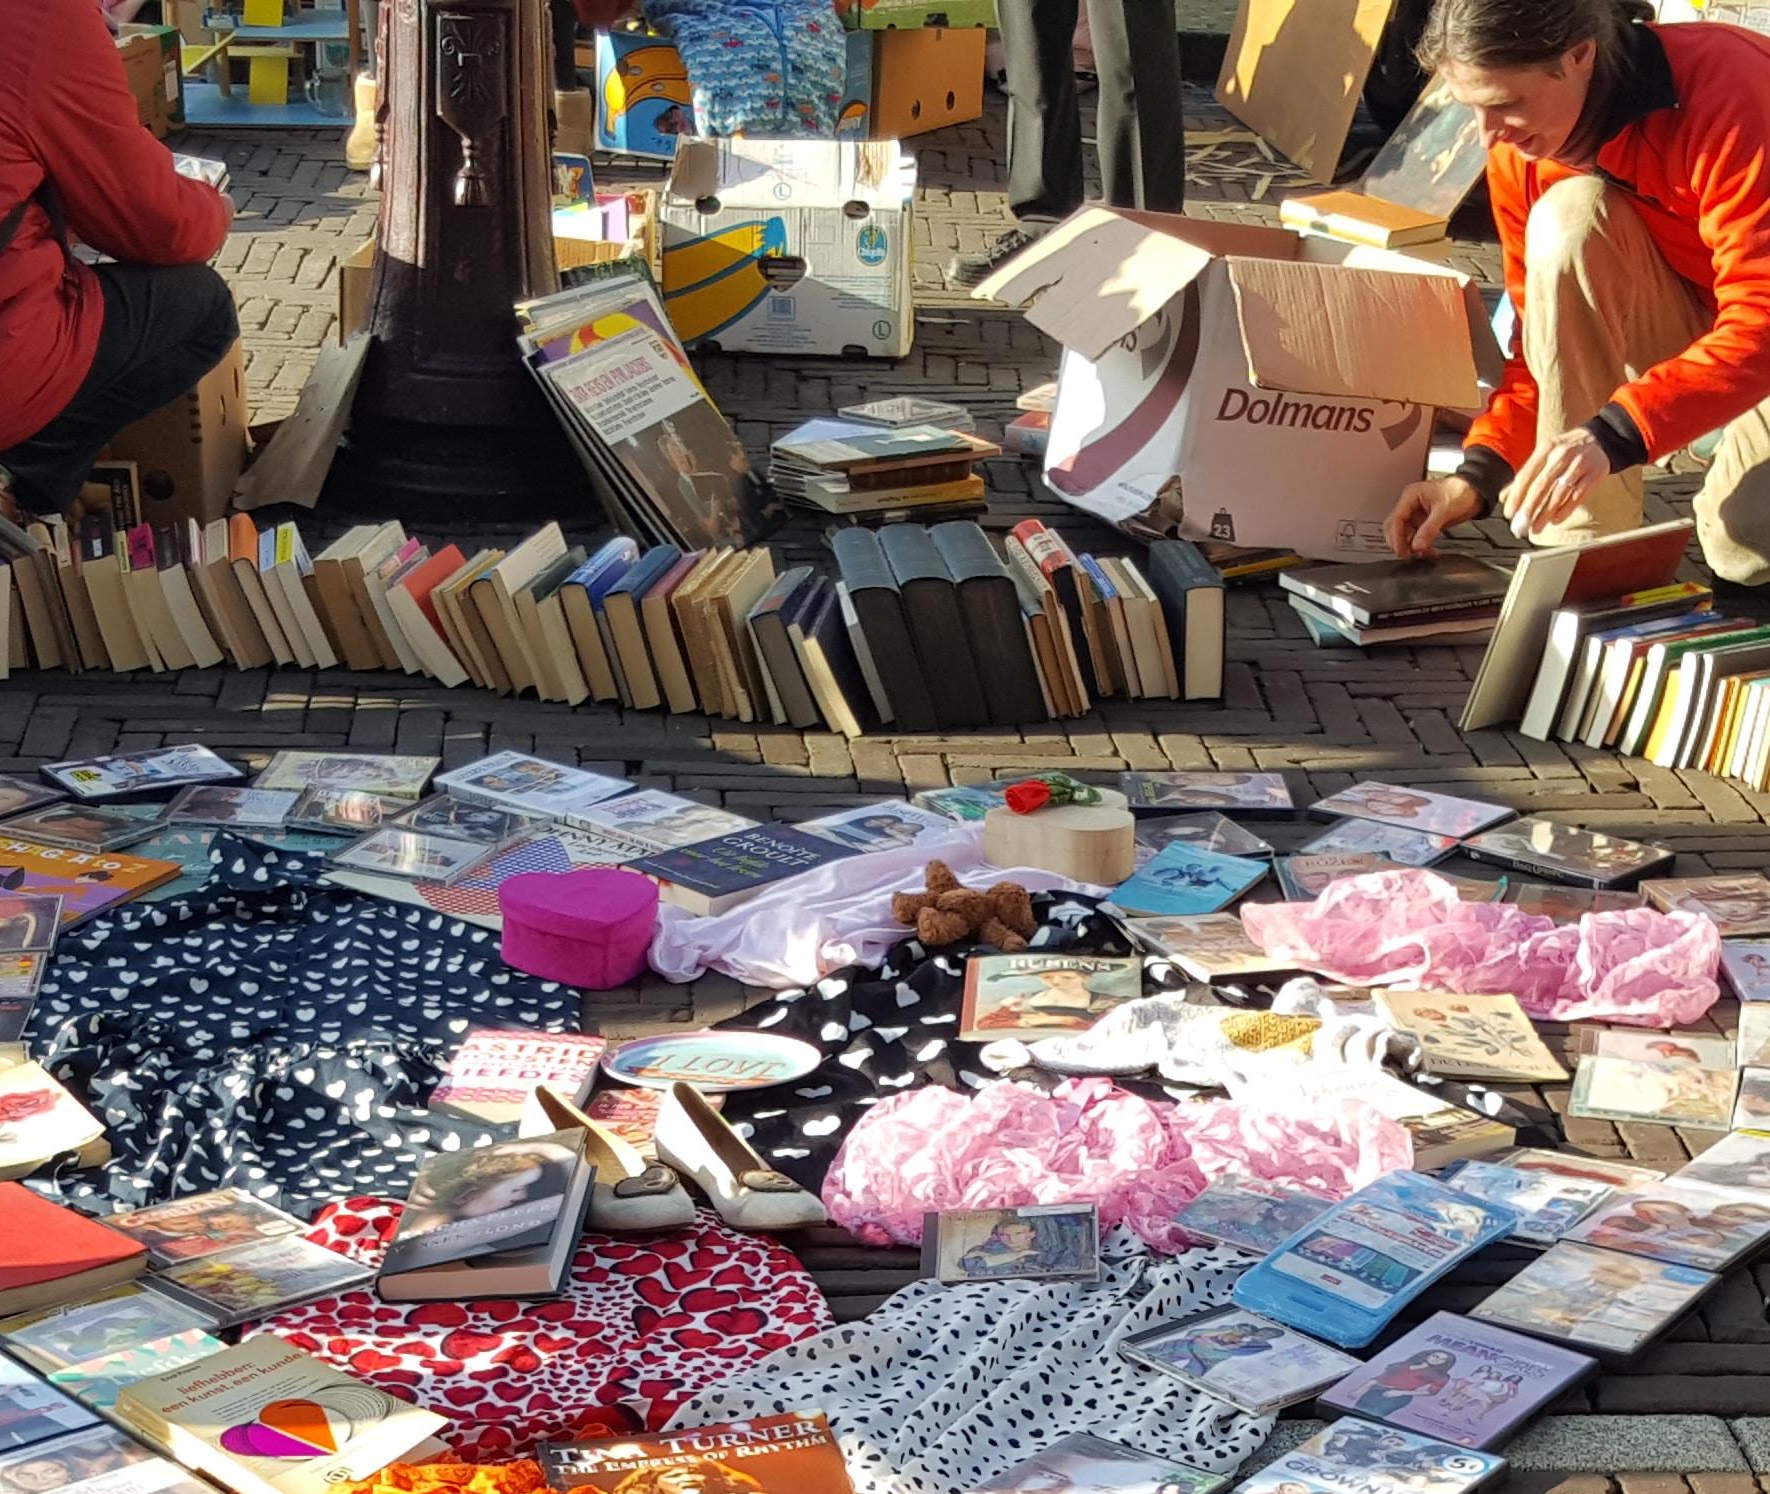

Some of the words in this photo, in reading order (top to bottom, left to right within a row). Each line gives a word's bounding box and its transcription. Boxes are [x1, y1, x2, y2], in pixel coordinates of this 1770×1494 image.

[1216, 388, 1375, 433] Dolmans
[1212, 524, 1231, 540] 23
[66, 851, 94, 866] A
[95, 857, 121, 871] to
[122, 860, 148, 875] Z
[722, 835, 810, 868] GROULT
[1009, 958, 1111, 971] RUBENS
[461, 1042, 598, 1059] ASTRID
[654, 1053, 676, 1067] I
[160, 1398, 190, 1415] een
[187, 1381, 235, 1404] kunst,
[231, 1370, 259, 1386] een
[255, 1350, 304, 1375] kunde
[174, 1359, 258, 1396] liefhebben:
[549, 1439, 647, 1466] TINA
[658, 1419, 822, 1455] TURNER
[555, 1461, 598, 1477] THE
[603, 1452, 699, 1473] EMPRESS
[702, 1448, 729, 1461] OF
[733, 1434, 828, 1458] RHYTHM
